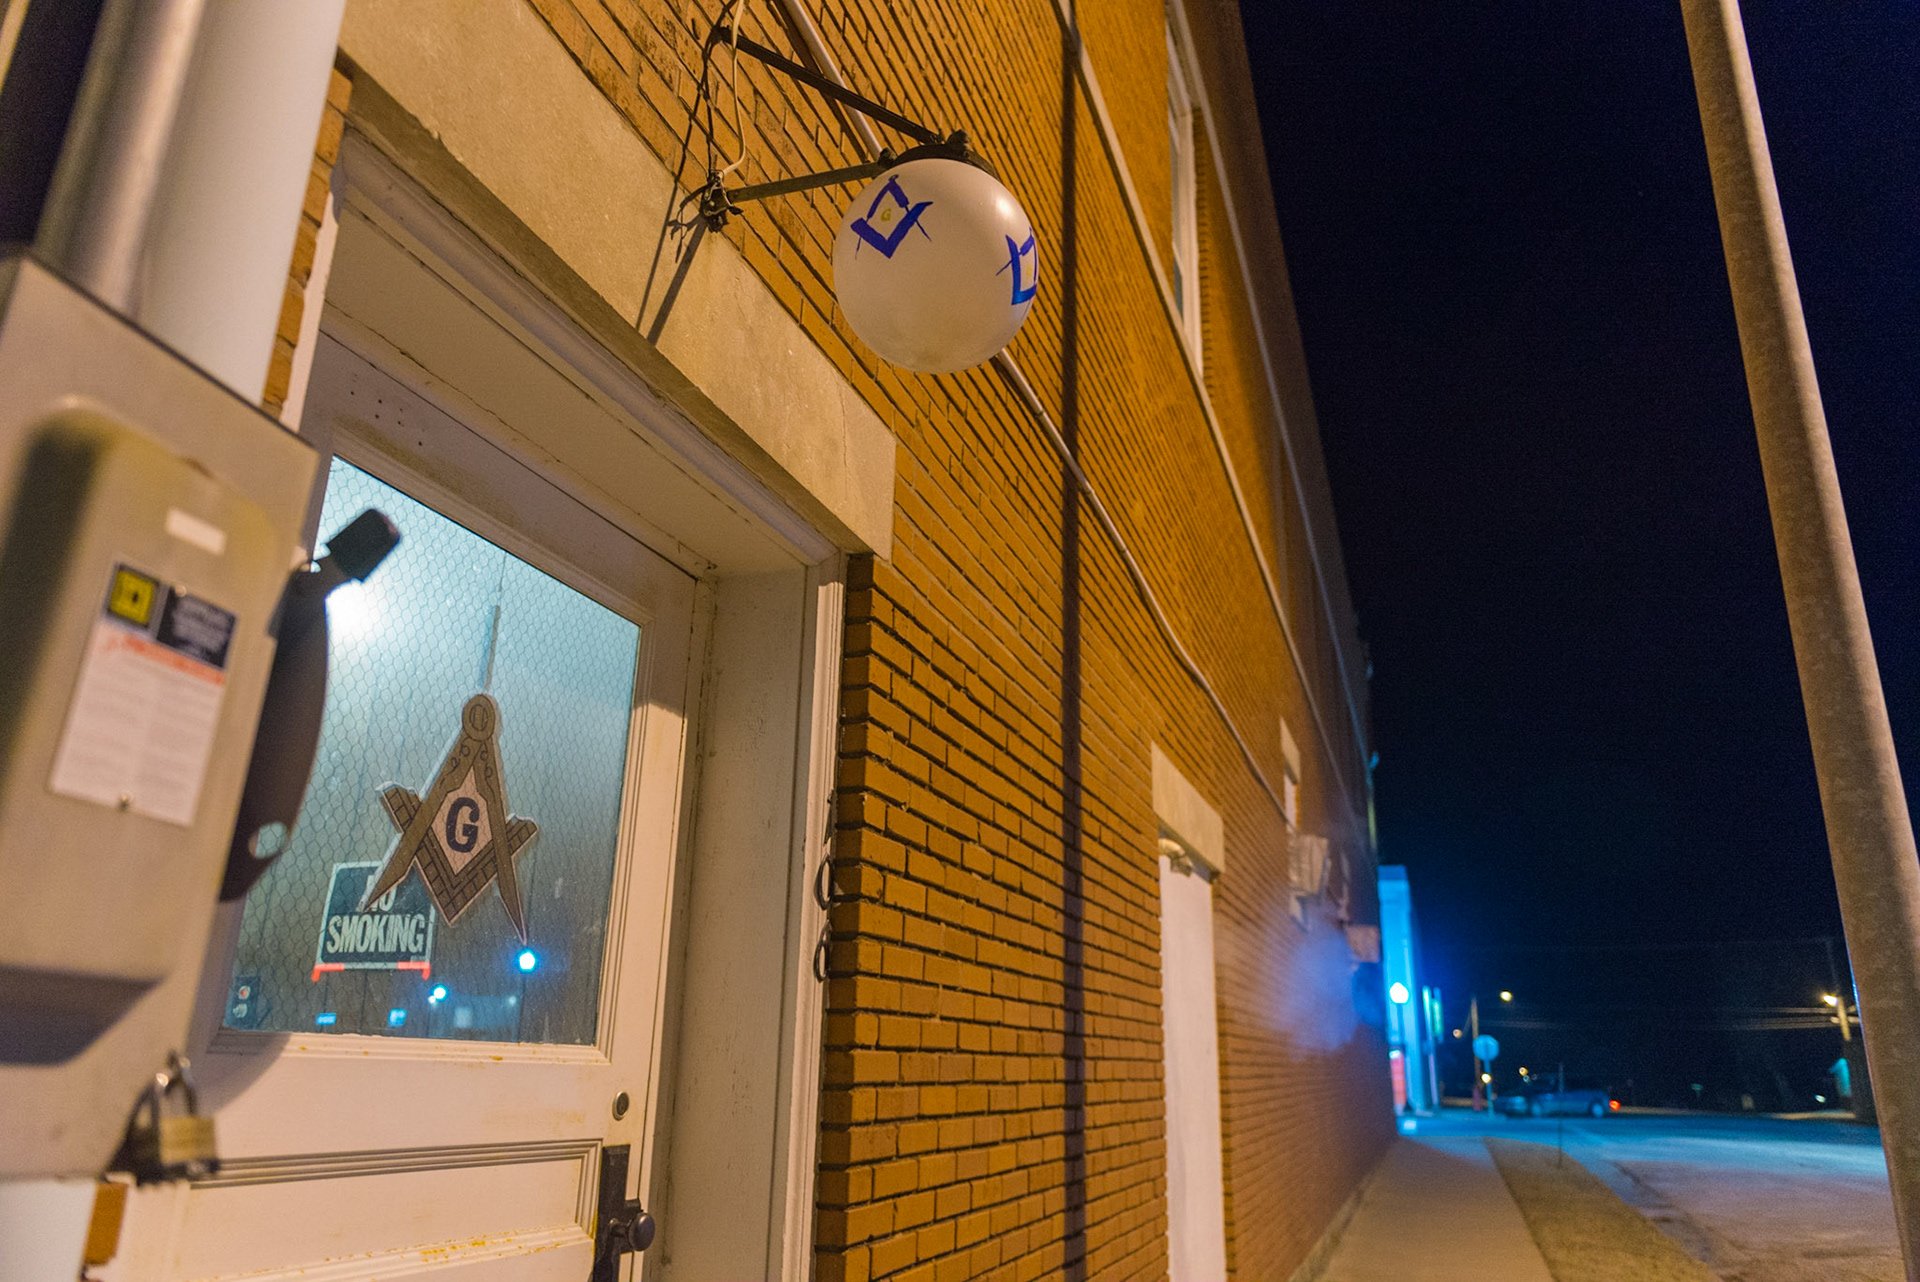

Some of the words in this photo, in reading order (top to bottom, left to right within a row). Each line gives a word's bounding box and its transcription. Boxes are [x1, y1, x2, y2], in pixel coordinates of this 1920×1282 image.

[881, 208, 892, 222] G
[445, 797, 480, 853] G
[356, 874, 398, 912] O
[326, 914, 426, 954] SMOKING
